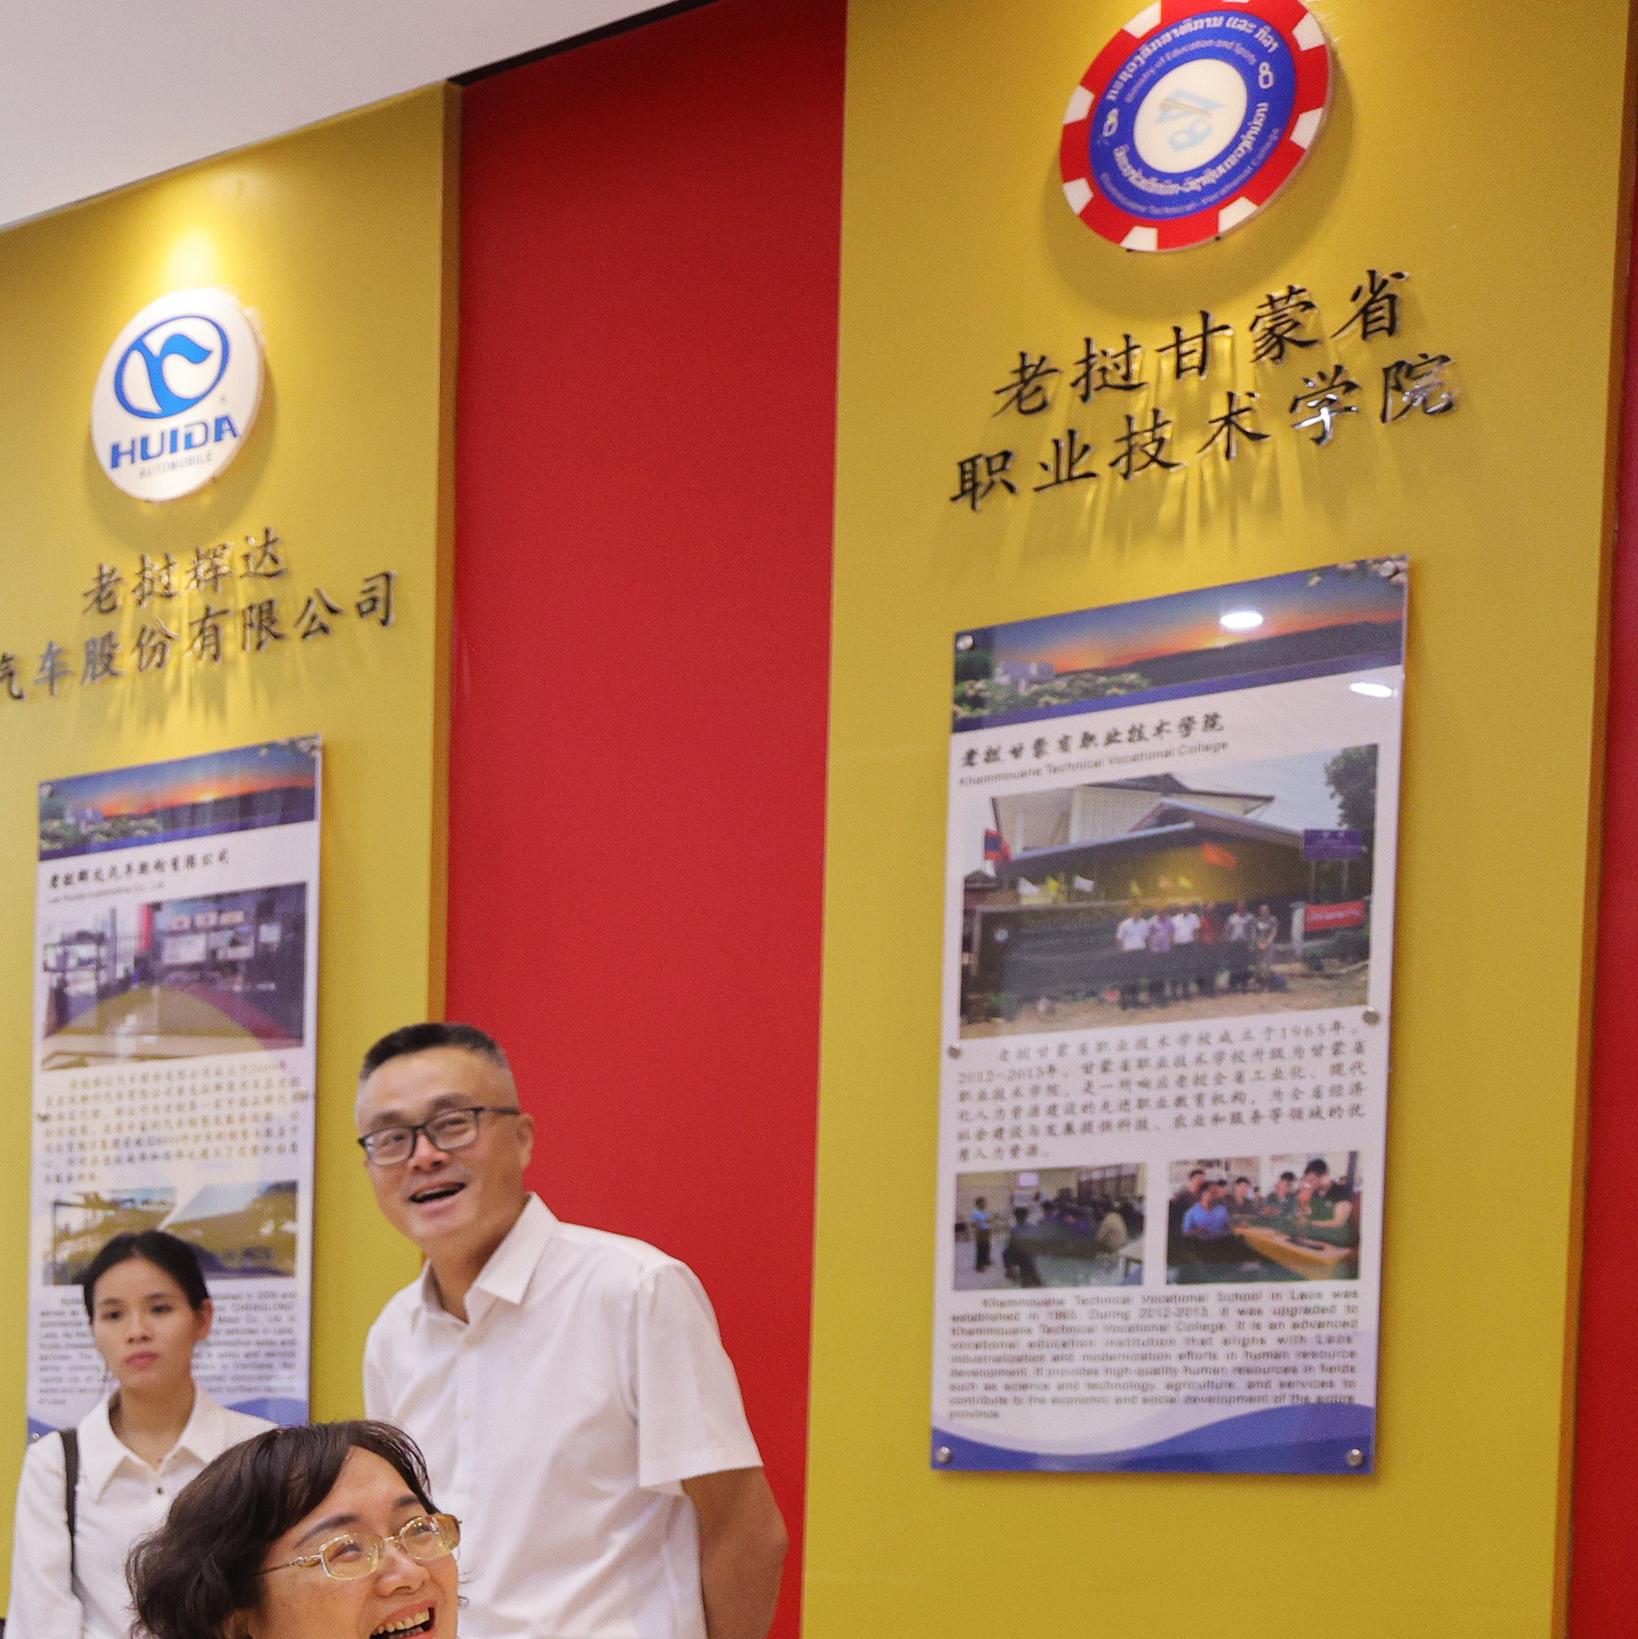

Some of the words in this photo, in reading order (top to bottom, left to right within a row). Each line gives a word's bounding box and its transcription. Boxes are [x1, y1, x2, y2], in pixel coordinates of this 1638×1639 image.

[992, 270, 1412, 418] 老挝甘蒙省
[110, 414, 240, 470] HUIDA
[951, 354, 1462, 511] 职业技术学院
[139, 450, 213, 479] AUTOMOBILE
[82, 526, 288, 616] 老挝辉达
[1044, 756, 1104, 777] Technical
[1107, 746, 1175, 768] Vocational
[1179, 738, 1229, 758] College
[1075, 1294, 1133, 1306] Technical
[1141, 1292, 1206, 1305] Vocational
[1217, 1290, 1262, 1303] School
[1289, 1289, 1323, 1301] Laos
[1332, 1290, 1359, 1300] was
[1237, 1307, 1264, 1317] was
[1272, 1304, 1337, 1318] upgraded
[1039, 1324, 1096, 1335] Technical
[1184, 1336, 1213, 1346] that
[1276, 1335, 1307, 1345] with
[1244, 1349, 1290, 1361] human
